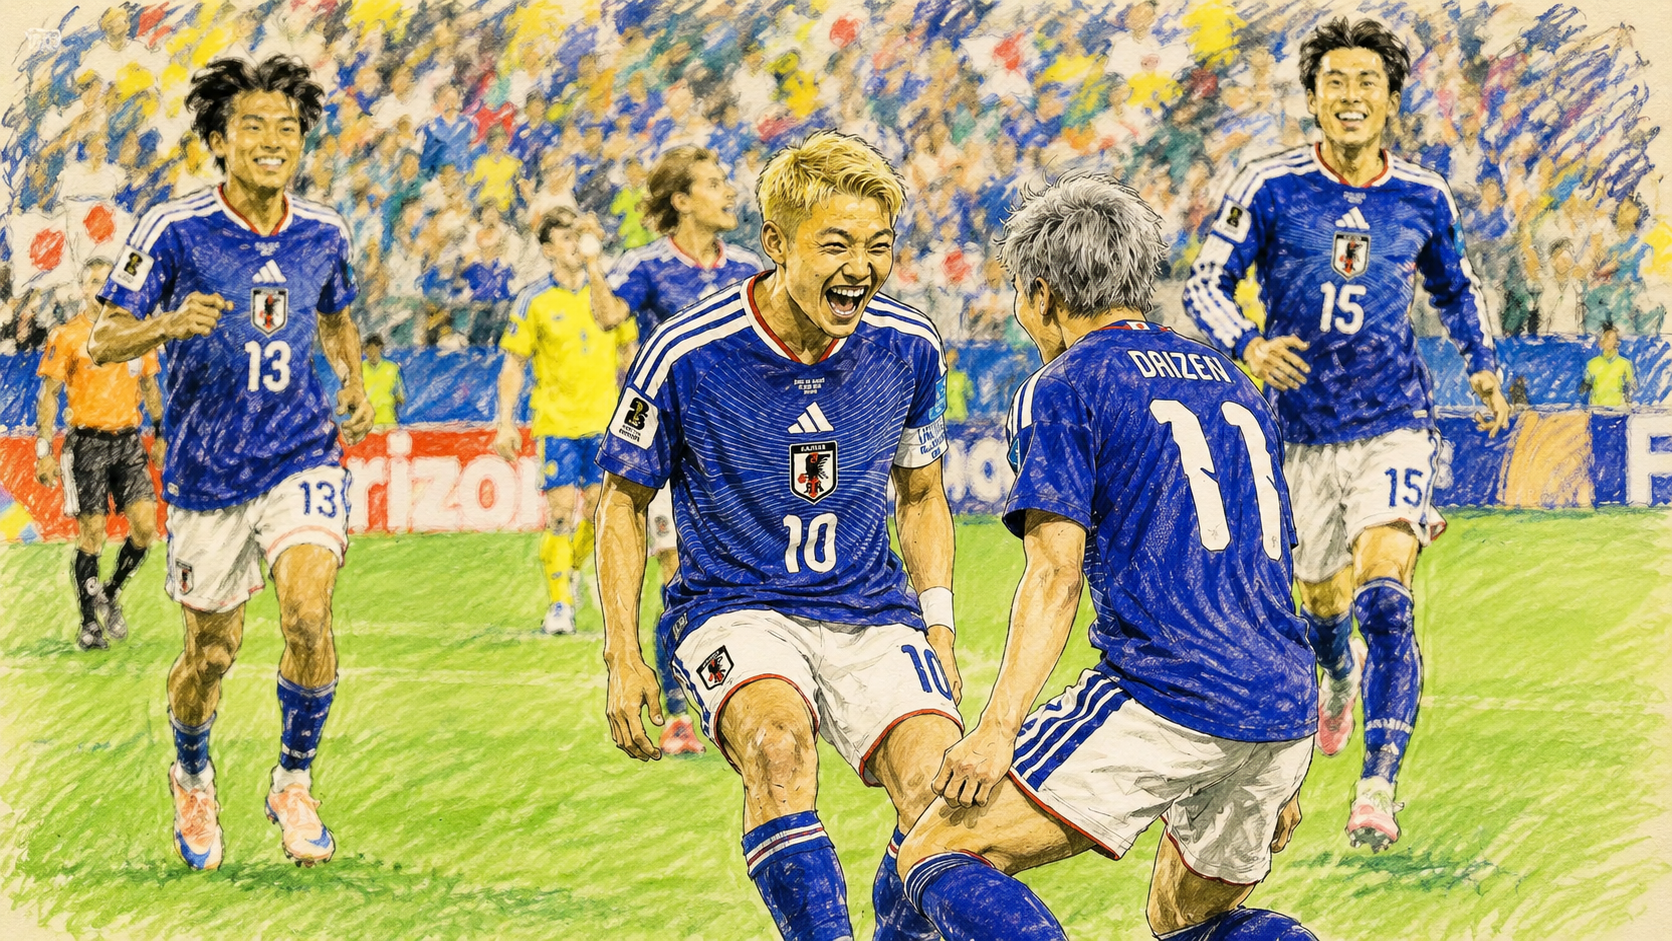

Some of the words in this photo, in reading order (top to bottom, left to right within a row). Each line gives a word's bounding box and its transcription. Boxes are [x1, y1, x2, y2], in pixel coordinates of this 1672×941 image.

[1319, 281, 1368, 335] 15
[244, 340, 292, 393] 13
[1127, 350, 1232, 383] DAIZEN
[299, 480, 337, 518] 13
[1149, 398, 1282, 561] 11
[1384, 466, 1424, 508] 15
[782, 512, 838, 574] 10
[900, 644, 952, 701] 10
